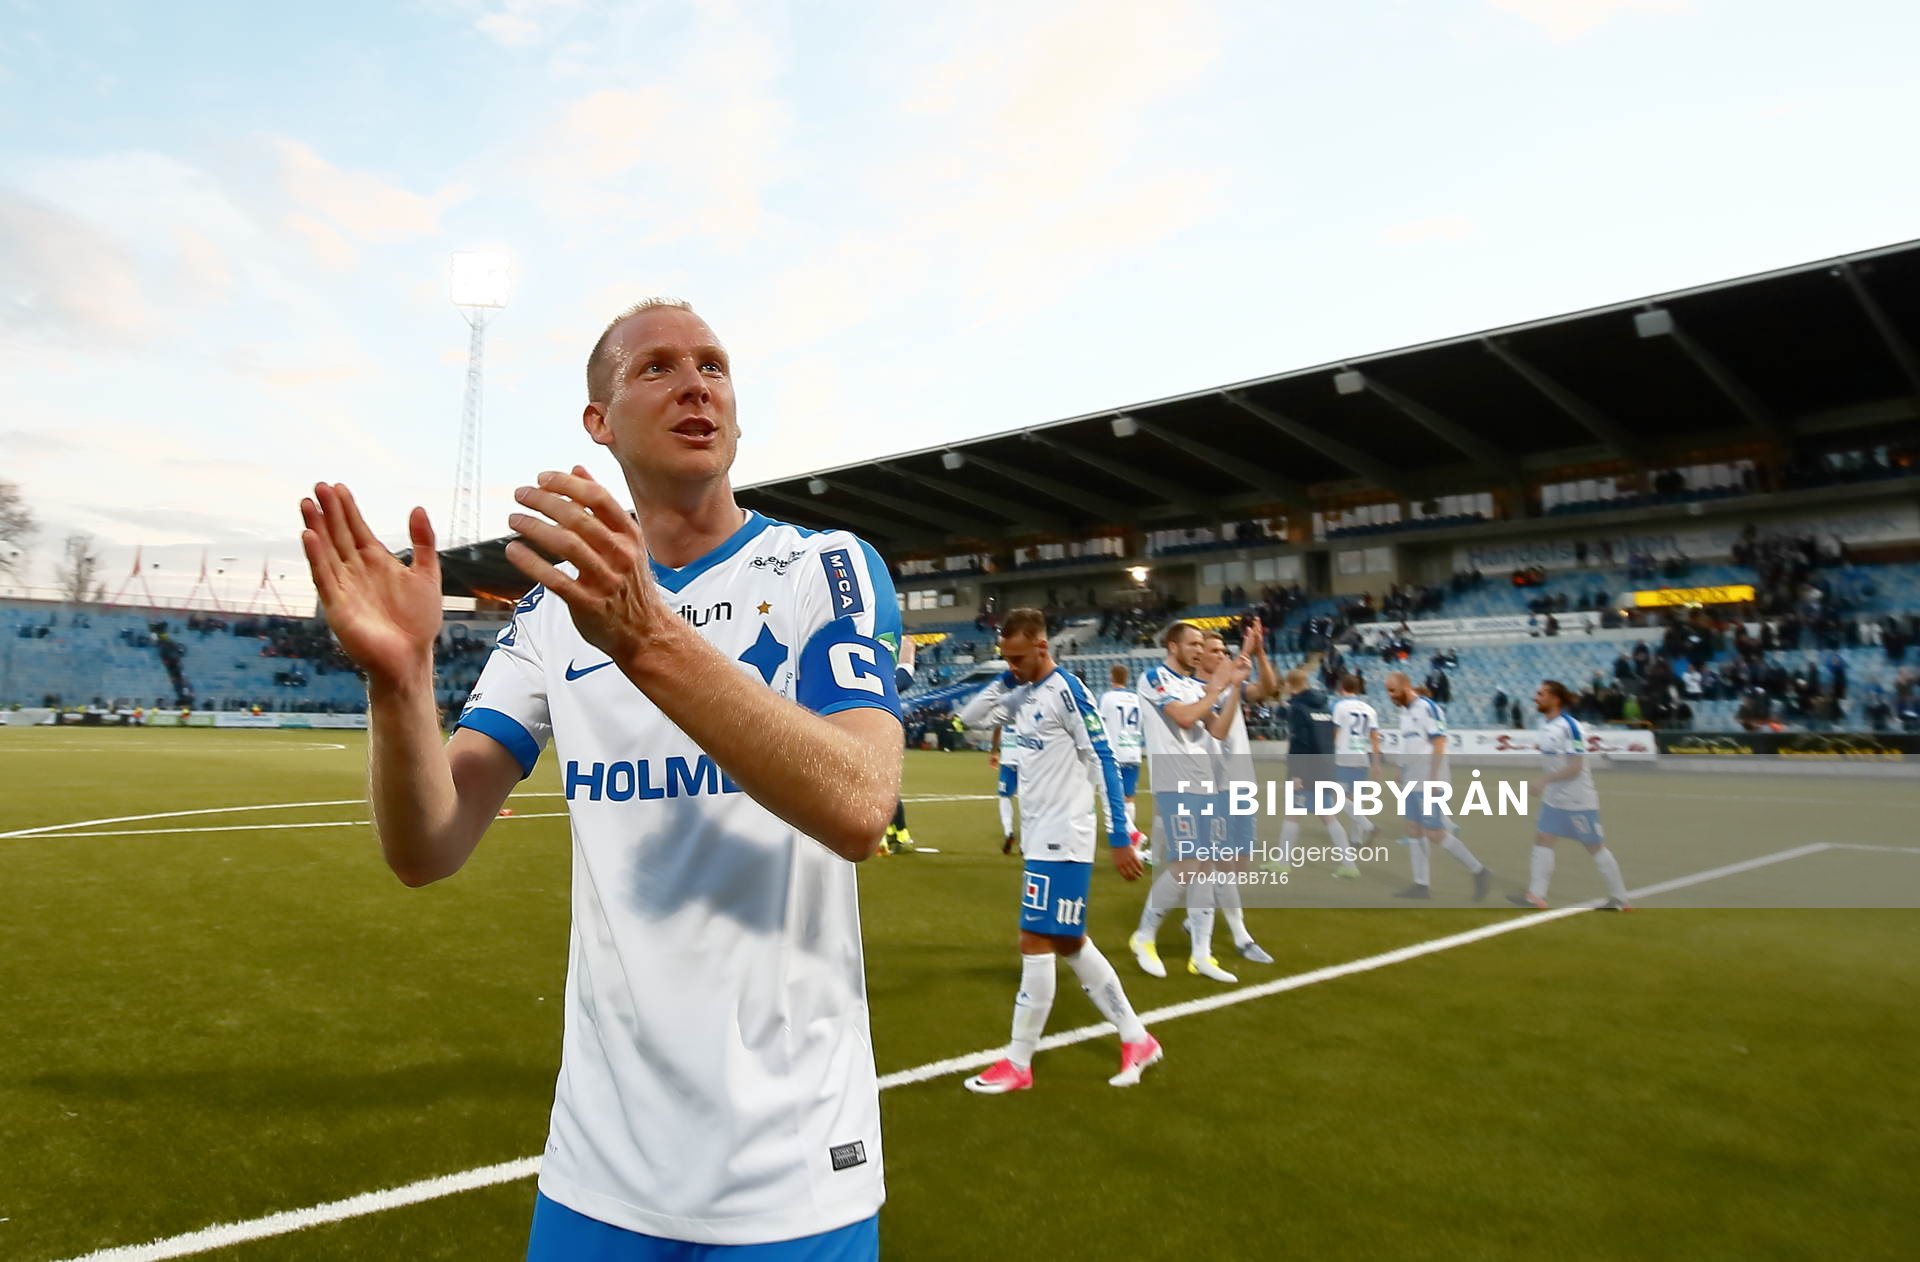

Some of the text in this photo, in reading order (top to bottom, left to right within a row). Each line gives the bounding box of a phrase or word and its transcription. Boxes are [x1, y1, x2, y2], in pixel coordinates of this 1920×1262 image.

[829, 554, 853, 609] MECA
[828, 642, 885, 697] C
[1116, 705, 1139, 729] 14
[1349, 711, 1369, 736] 21
